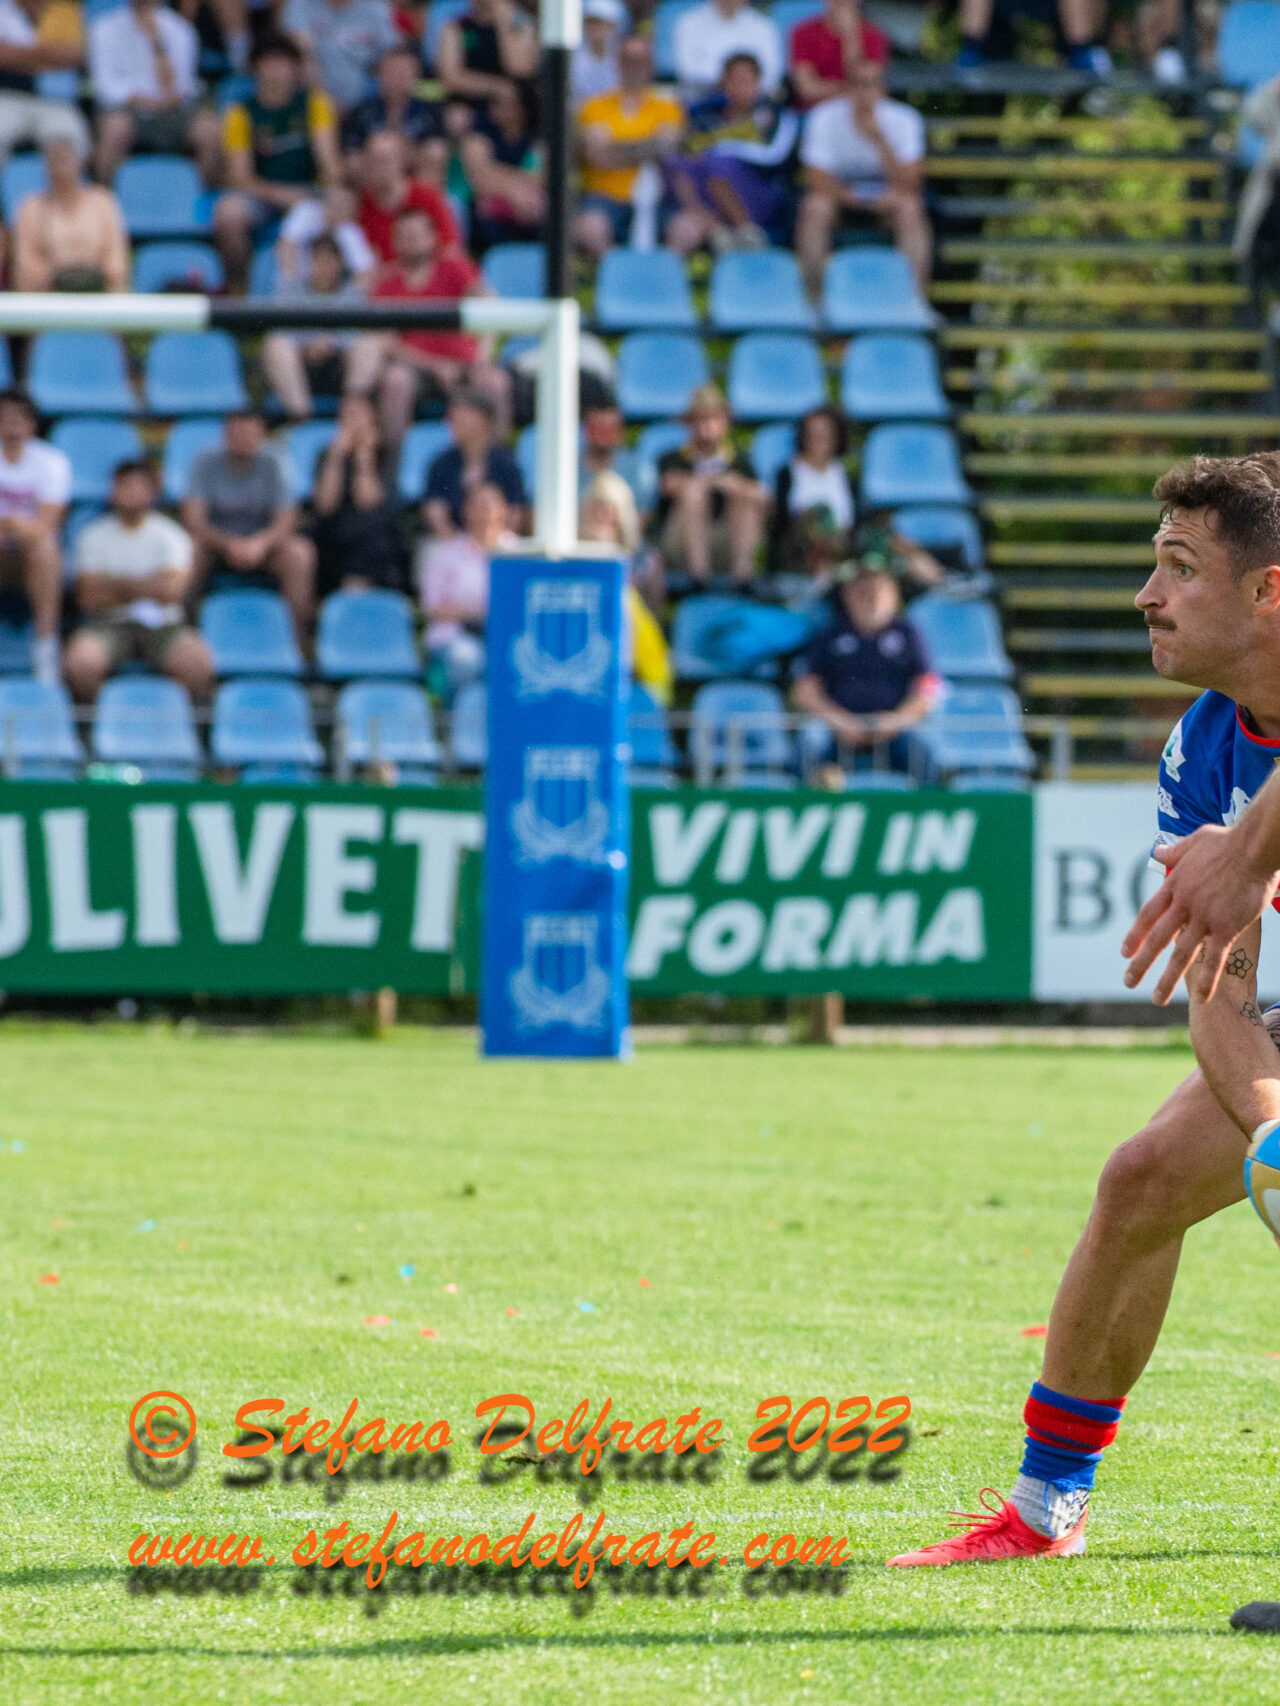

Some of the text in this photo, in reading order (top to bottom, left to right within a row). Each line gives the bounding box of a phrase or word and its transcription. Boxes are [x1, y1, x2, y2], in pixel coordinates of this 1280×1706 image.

[649, 802, 977, 887] VIVI IN
[624, 886, 986, 980] FORMA
